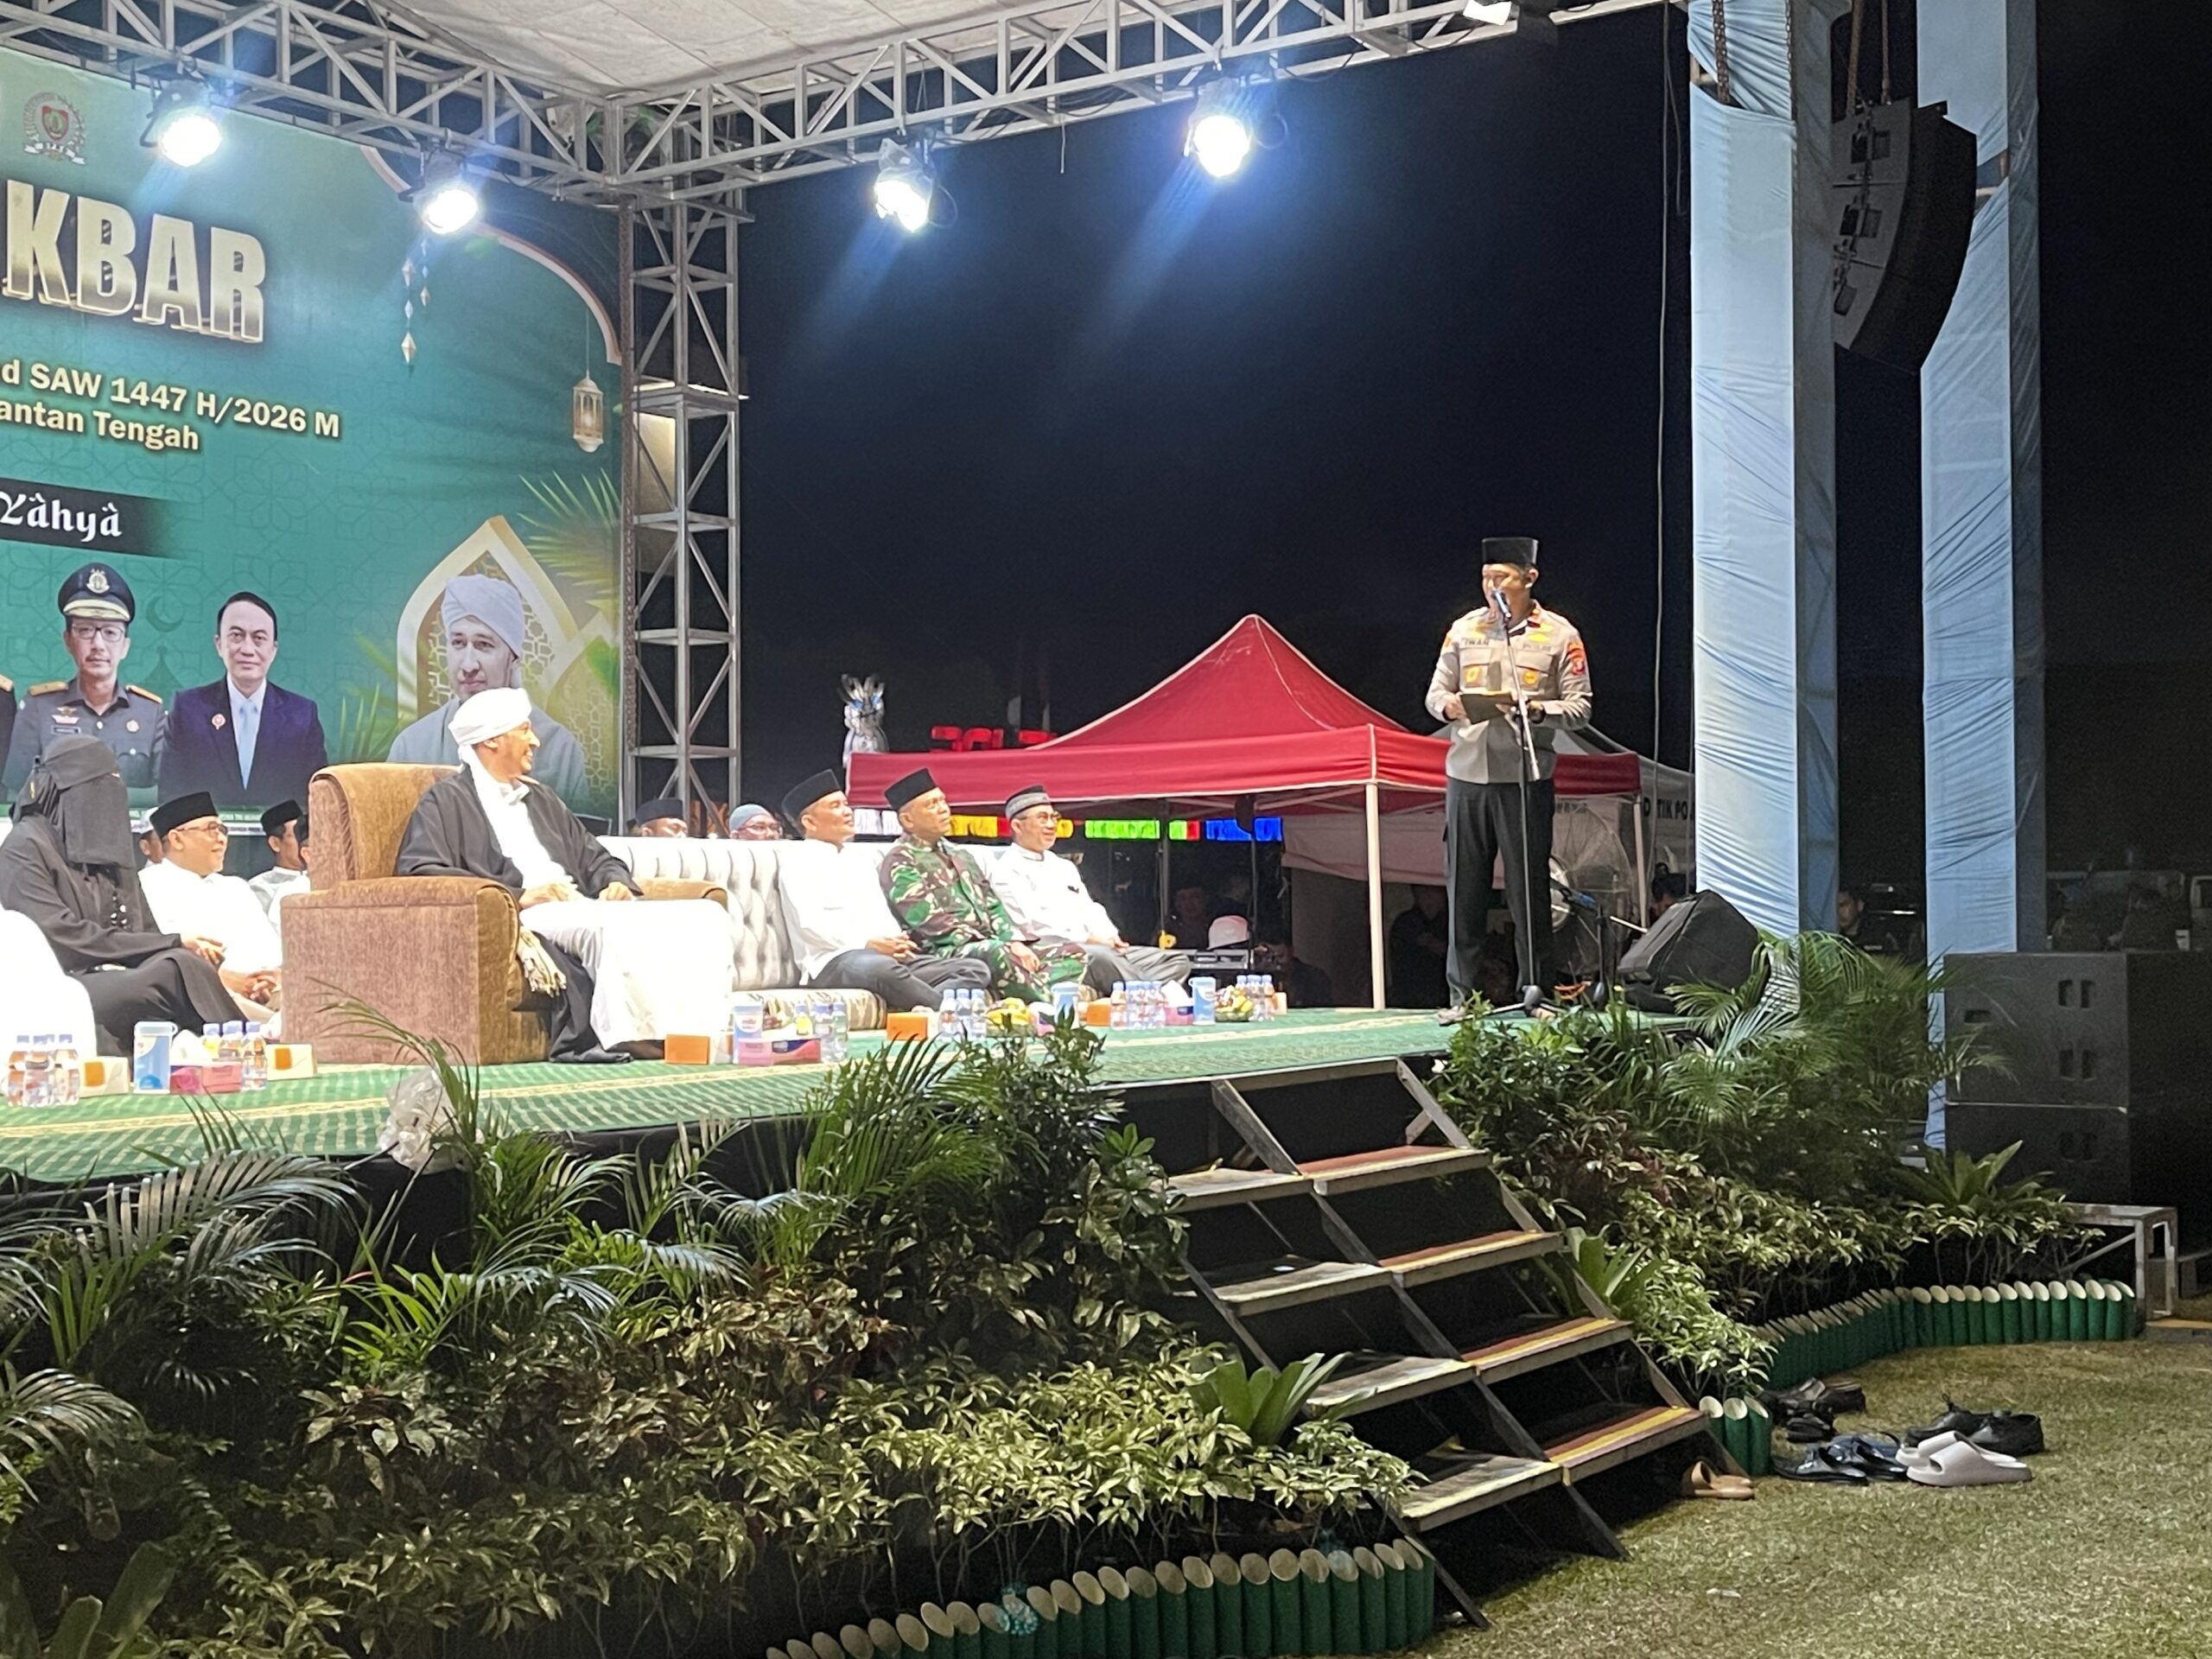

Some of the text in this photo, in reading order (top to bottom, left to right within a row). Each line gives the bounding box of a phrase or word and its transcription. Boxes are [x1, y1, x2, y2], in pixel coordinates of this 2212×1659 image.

[29, 362, 102, 398] SAW
[110, 378, 188, 412] 1447
[196, 391, 307, 433] H/2026
[315, 411, 340, 438] M
[92, 410, 200, 451] Tengah
